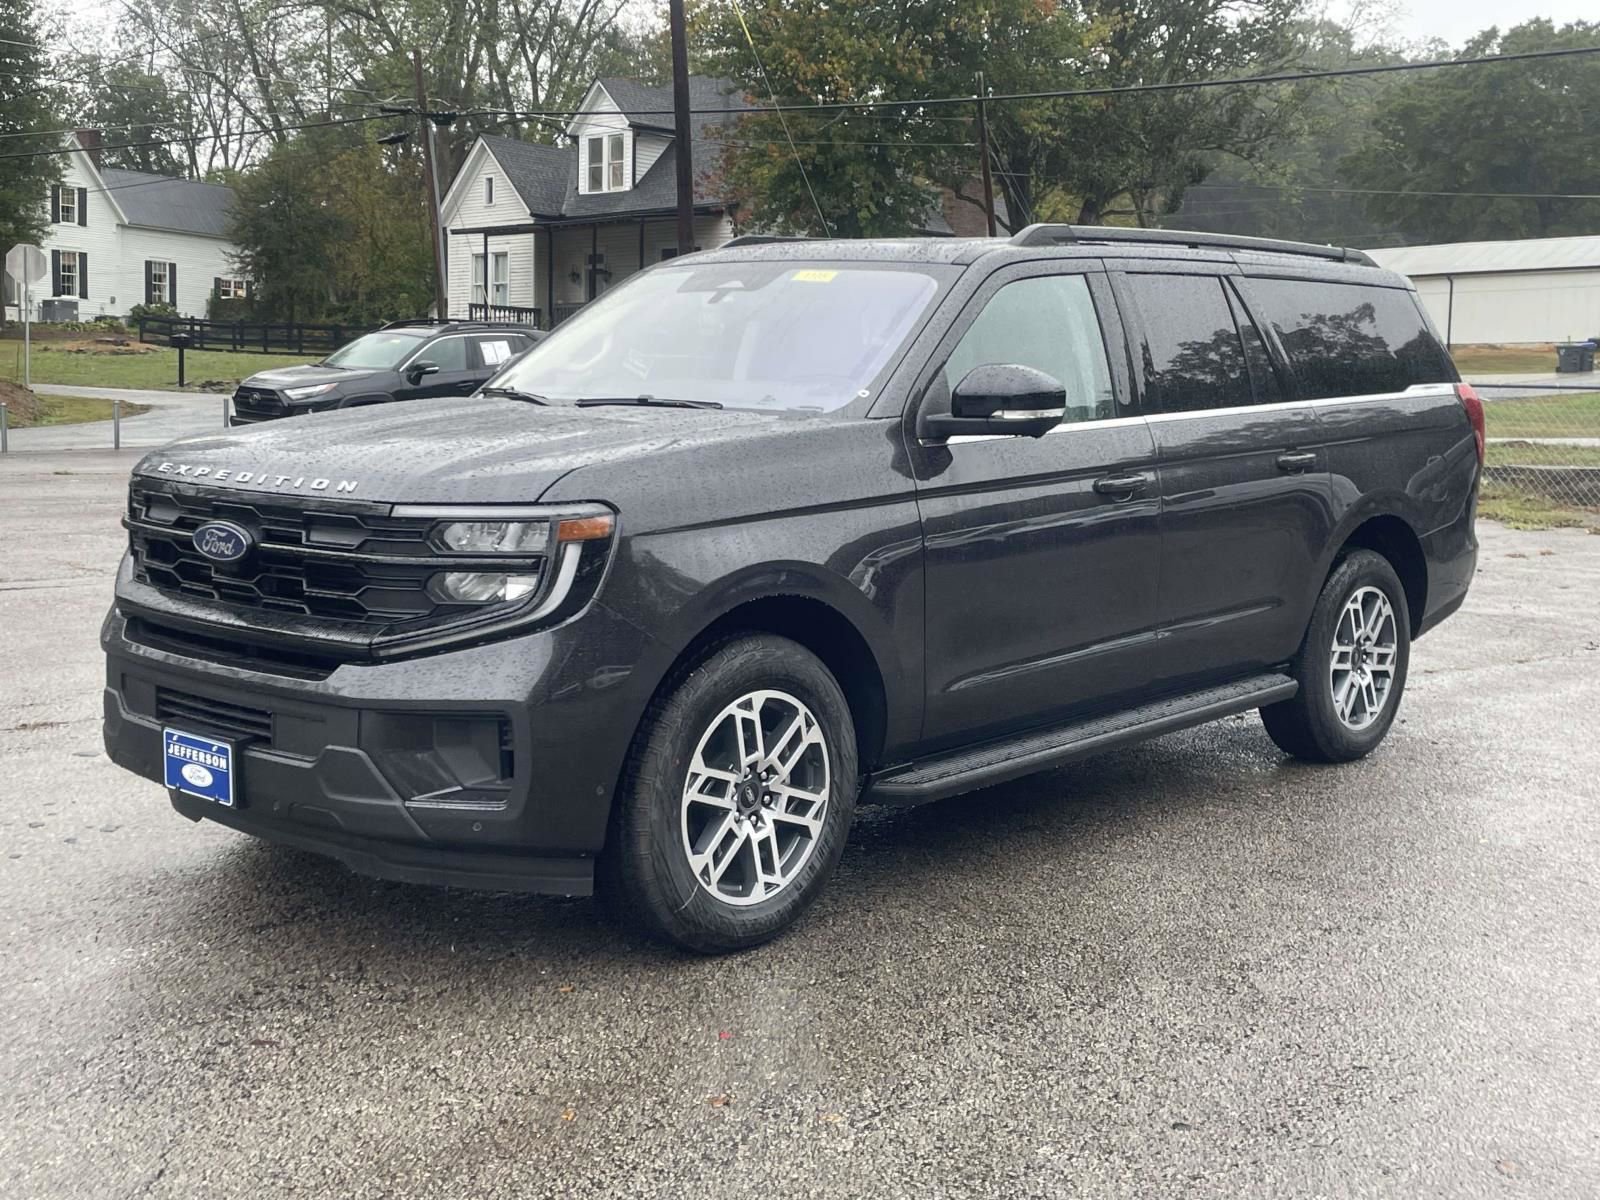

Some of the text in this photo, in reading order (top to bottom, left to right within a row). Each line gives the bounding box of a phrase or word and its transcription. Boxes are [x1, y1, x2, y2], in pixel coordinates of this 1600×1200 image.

[157, 462, 359, 493] EXPEDITION
[202, 528, 236, 556] Ford
[167, 743, 228, 770] JEFFERSON
